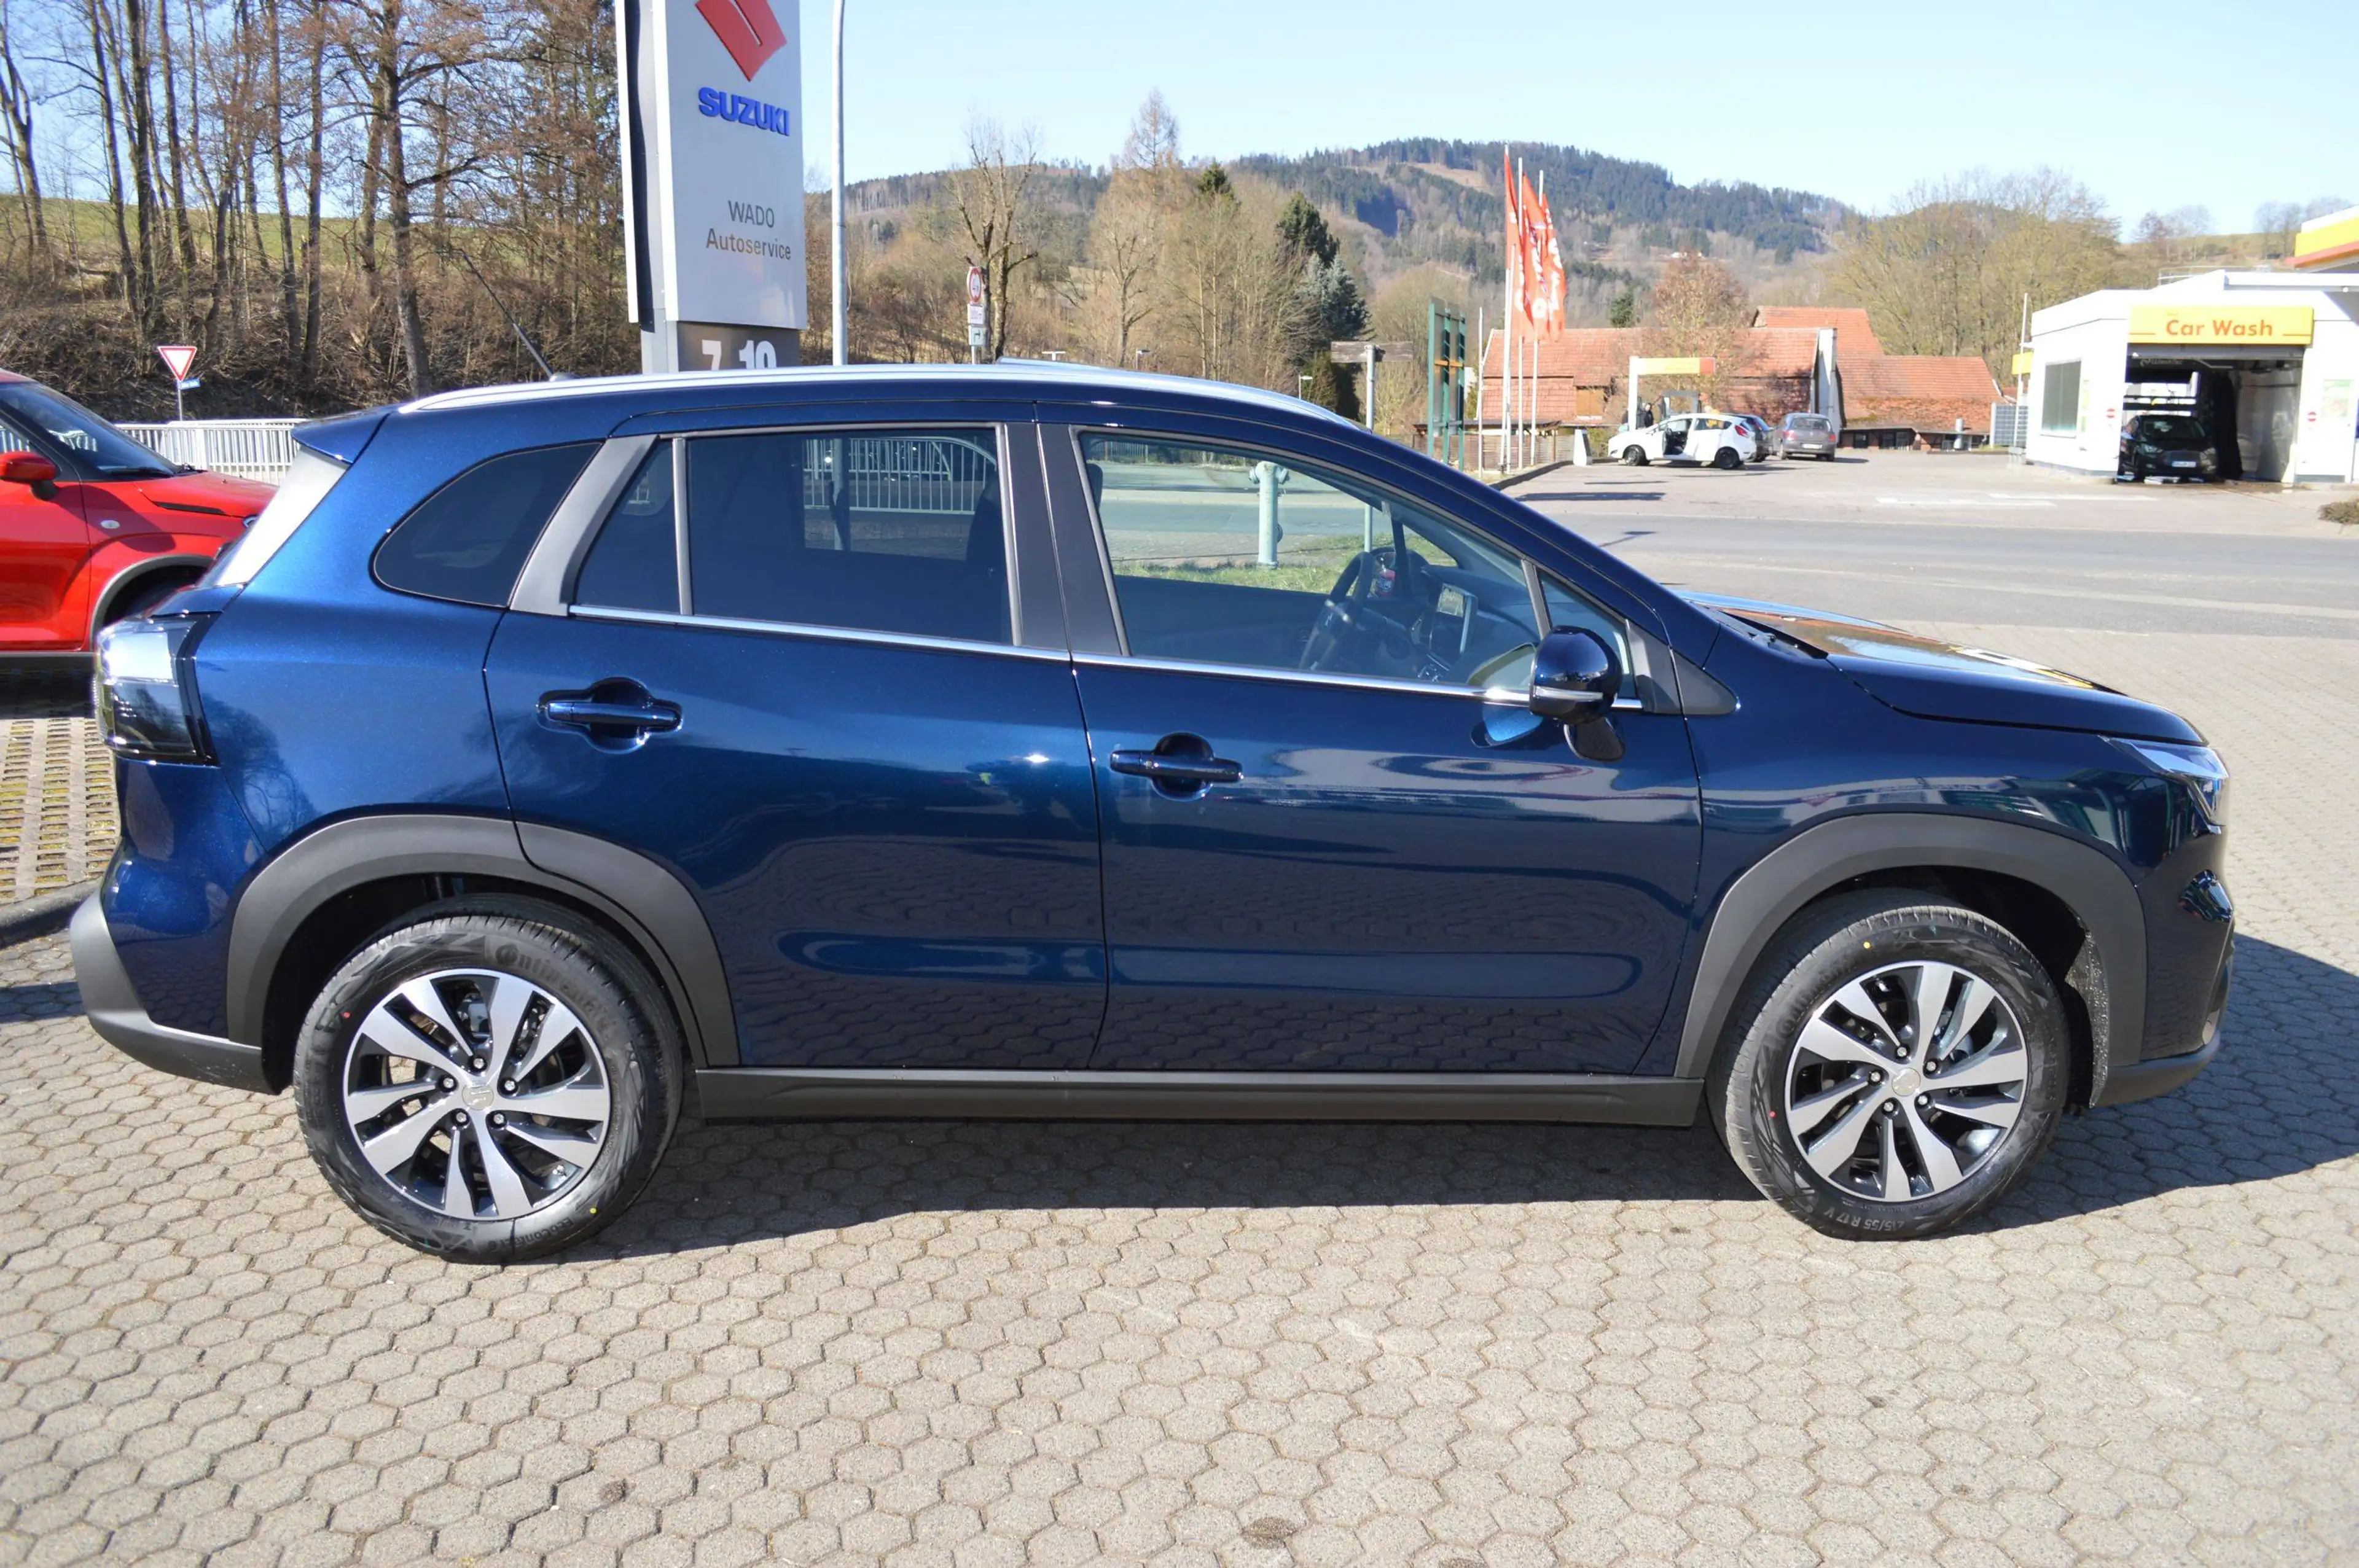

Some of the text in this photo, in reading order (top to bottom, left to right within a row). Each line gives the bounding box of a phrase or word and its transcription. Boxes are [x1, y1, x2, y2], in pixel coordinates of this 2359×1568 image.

[698, 87, 789, 136] SUZUKI
[728, 200, 775, 228] WADO
[706, 228, 791, 260] Autoservice
[2166, 319, 2273, 337] Car Wash
